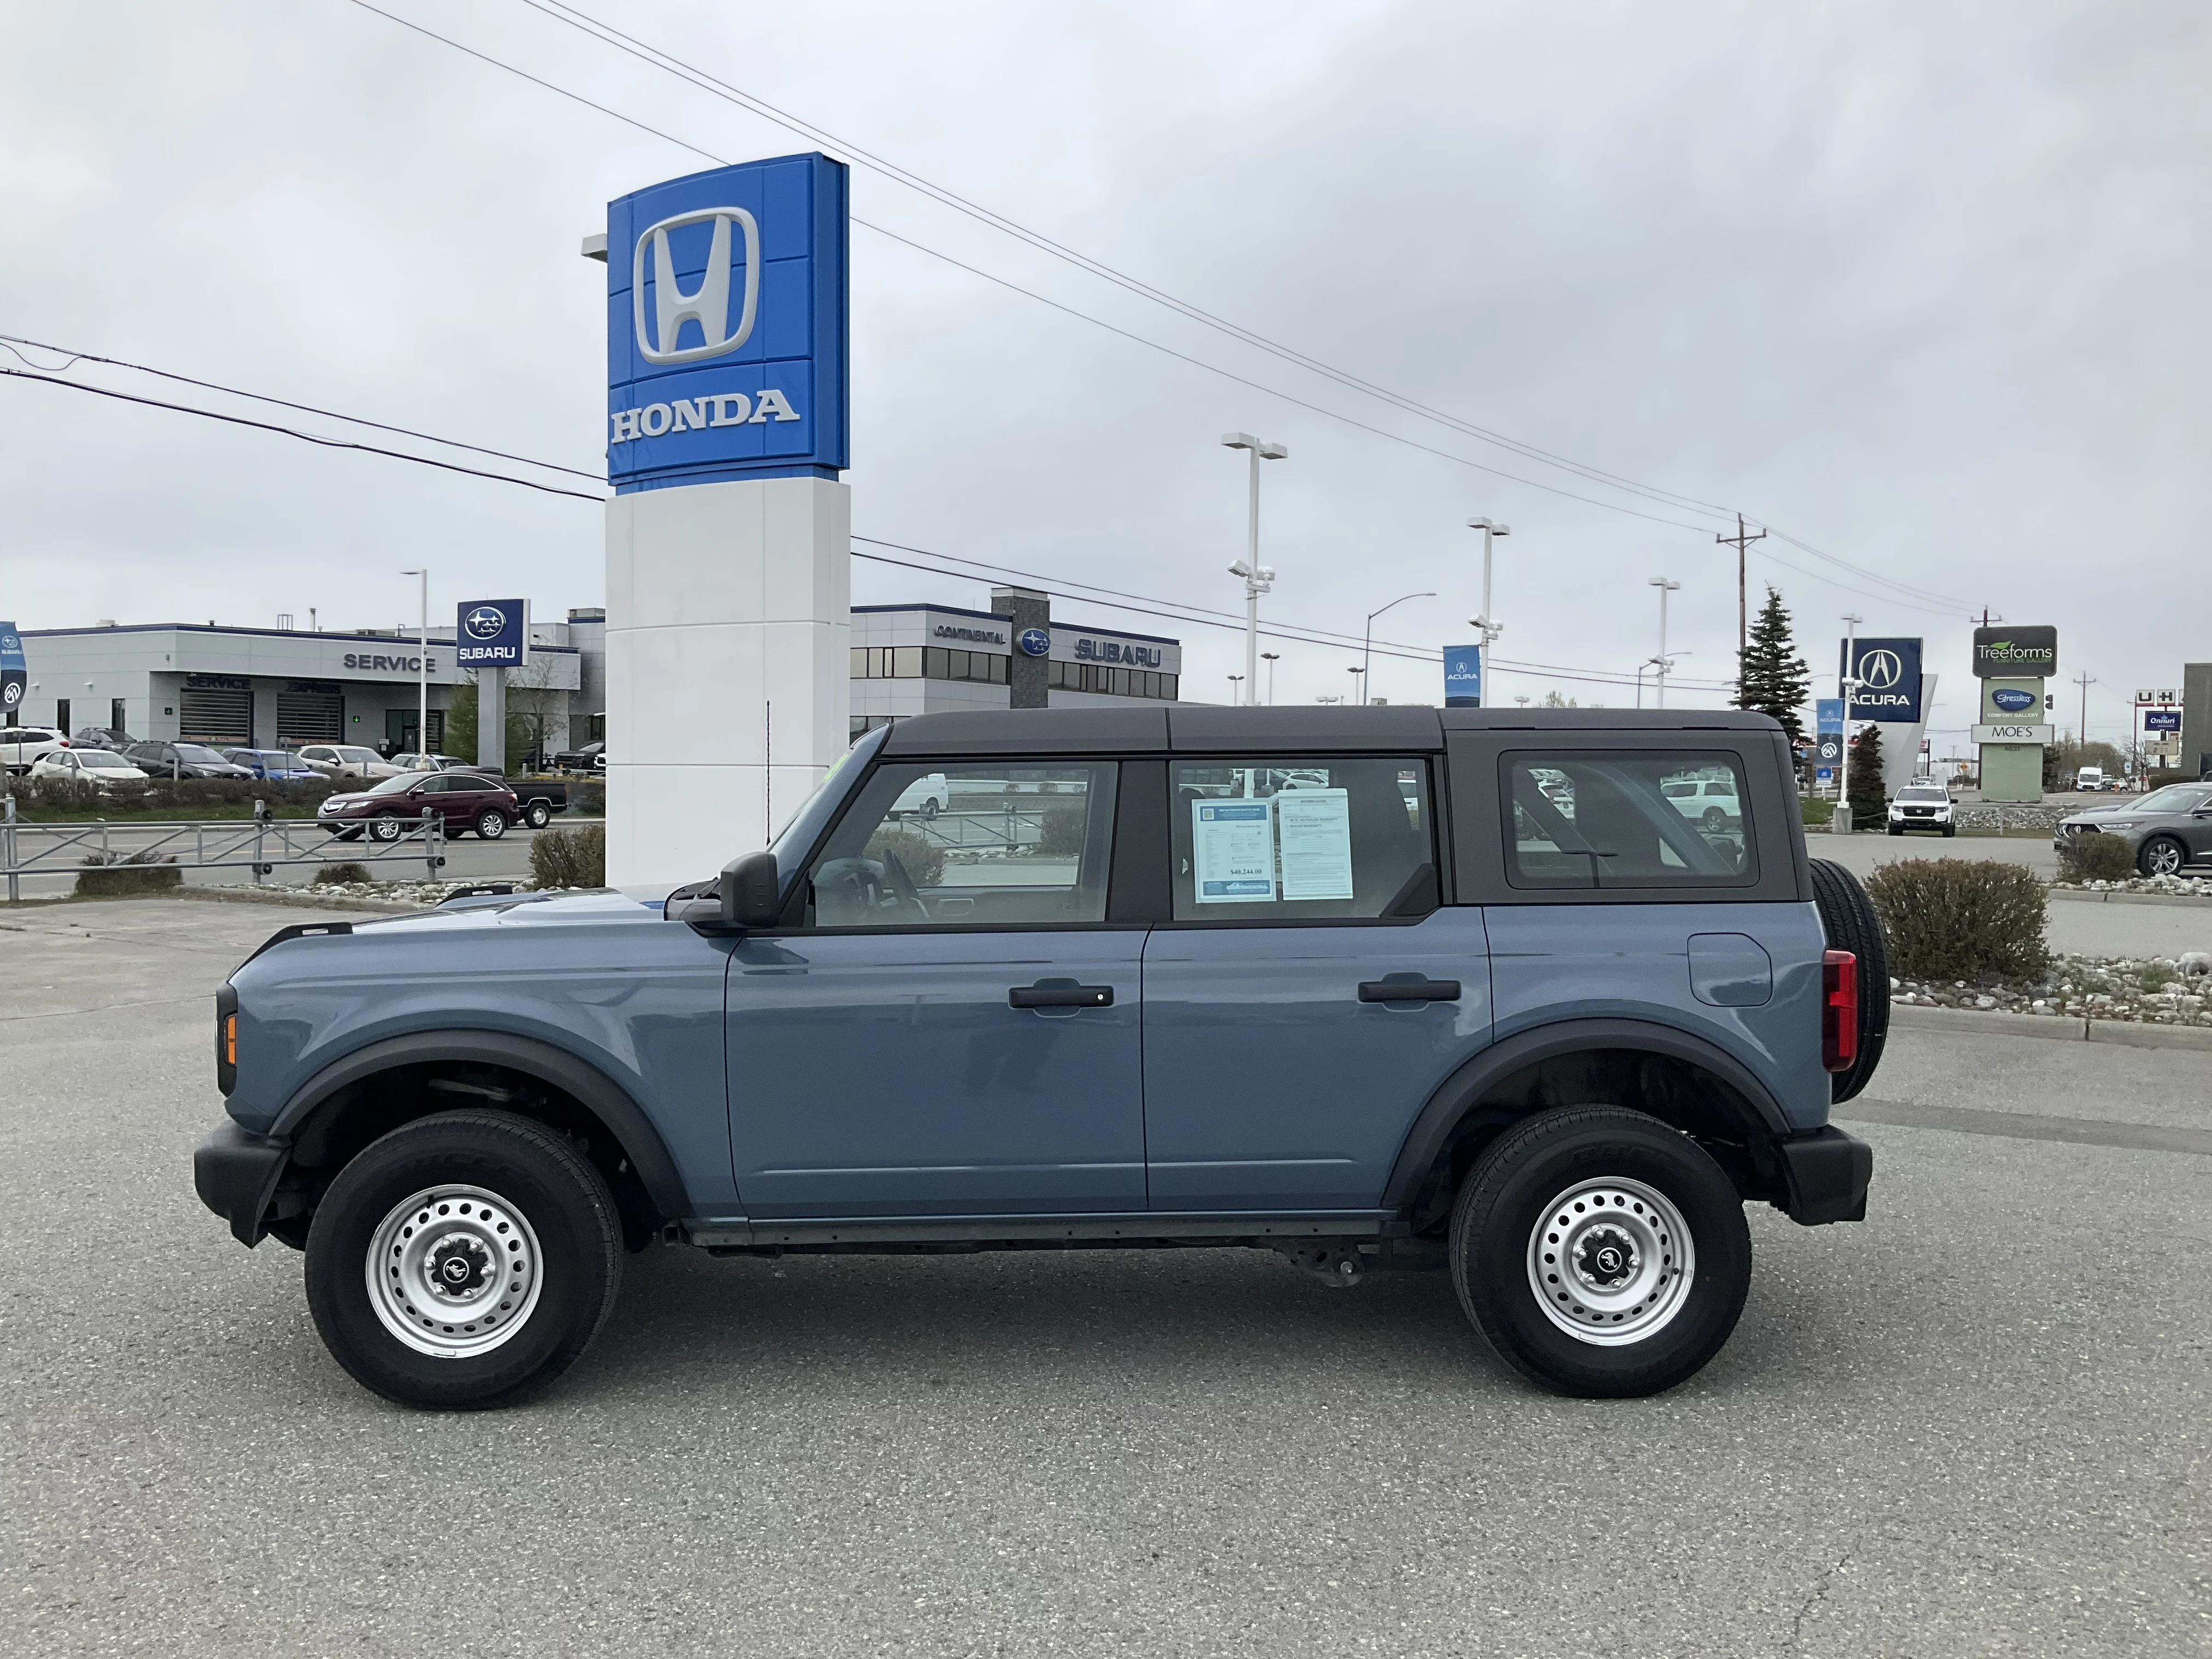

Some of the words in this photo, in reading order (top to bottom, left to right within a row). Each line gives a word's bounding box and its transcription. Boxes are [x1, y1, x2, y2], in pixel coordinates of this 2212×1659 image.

[611, 388, 801, 444] HONDA
[934, 625, 1006, 645] CONTINENTAL
[459, 646, 516, 660] SUBARU
[1075, 638, 1161, 668] SUBARU
[1977, 644, 2052, 659] Treeforms
[344, 653, 436, 672] SERVICE
[187, 675, 251, 690] SERVICE
[1849, 695, 1910, 706] ACURA
[1997, 694, 2032, 703] Stressless
[1991, 726, 2033, 737] MOE'S
